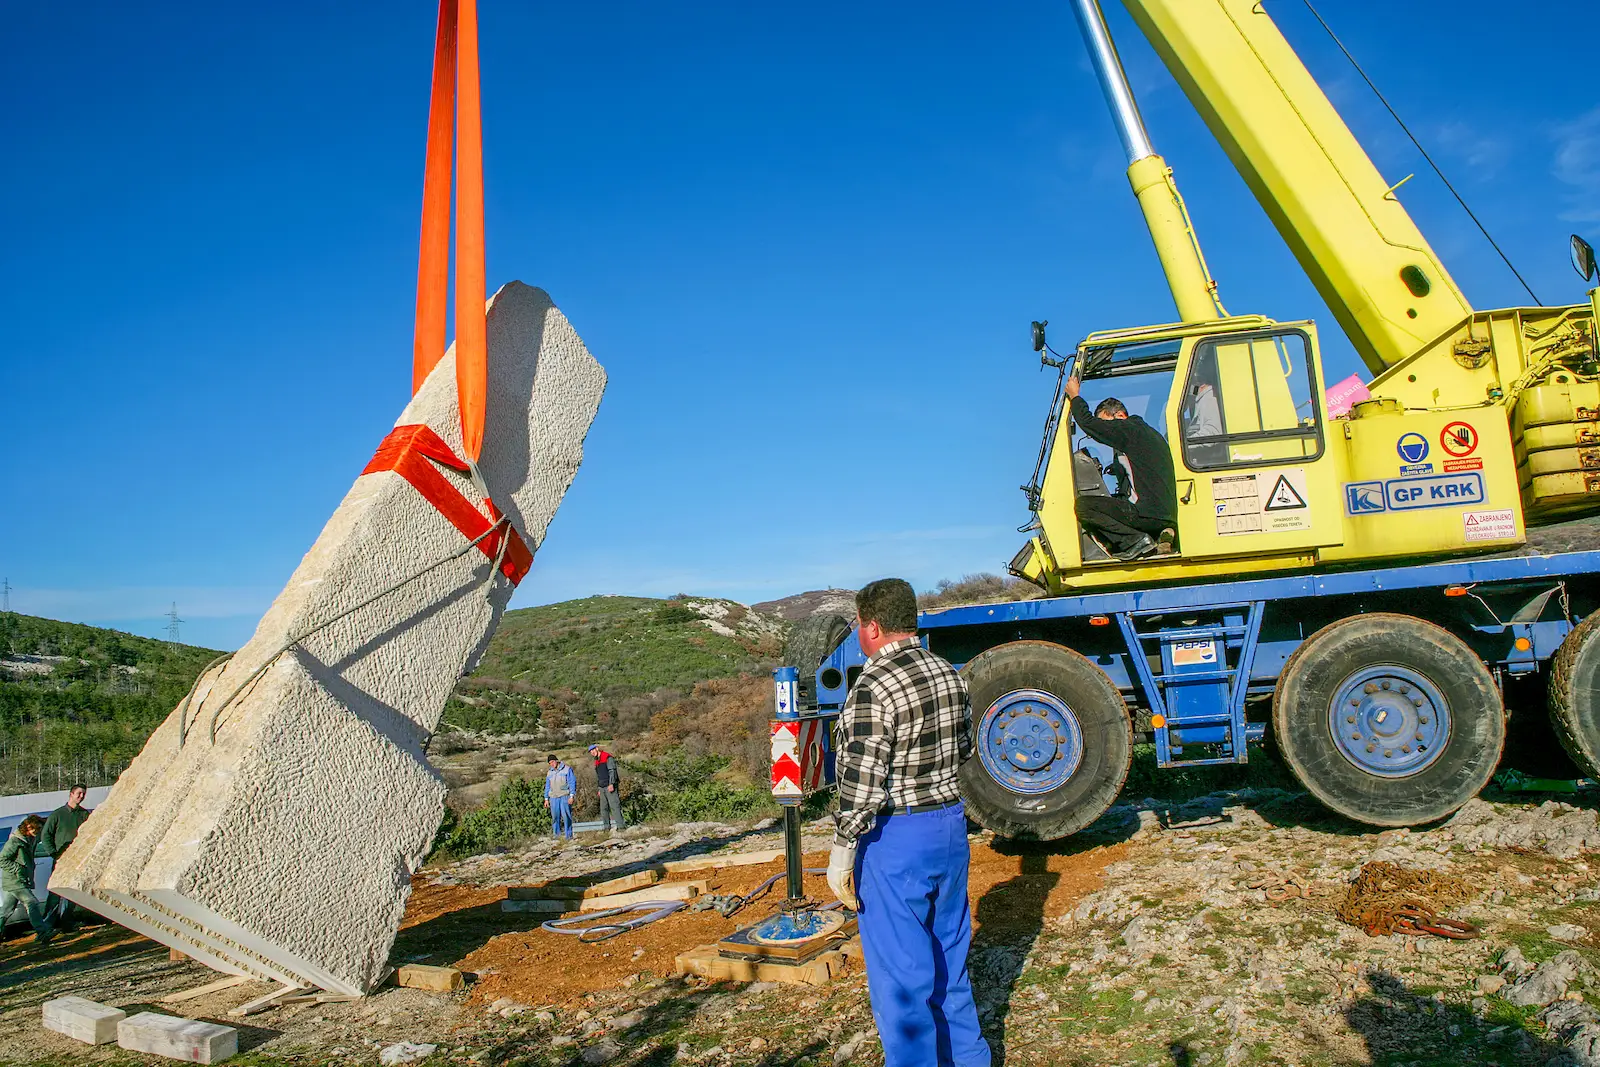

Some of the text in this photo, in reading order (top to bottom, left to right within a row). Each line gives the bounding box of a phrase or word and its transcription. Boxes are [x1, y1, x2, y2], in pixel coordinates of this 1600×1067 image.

[1394, 487, 1424, 502] GP
[1430, 482, 1476, 499] KRK
[1480, 514, 1511, 522] ZABRANJENO
[1175, 640, 1210, 650] PEPSI
